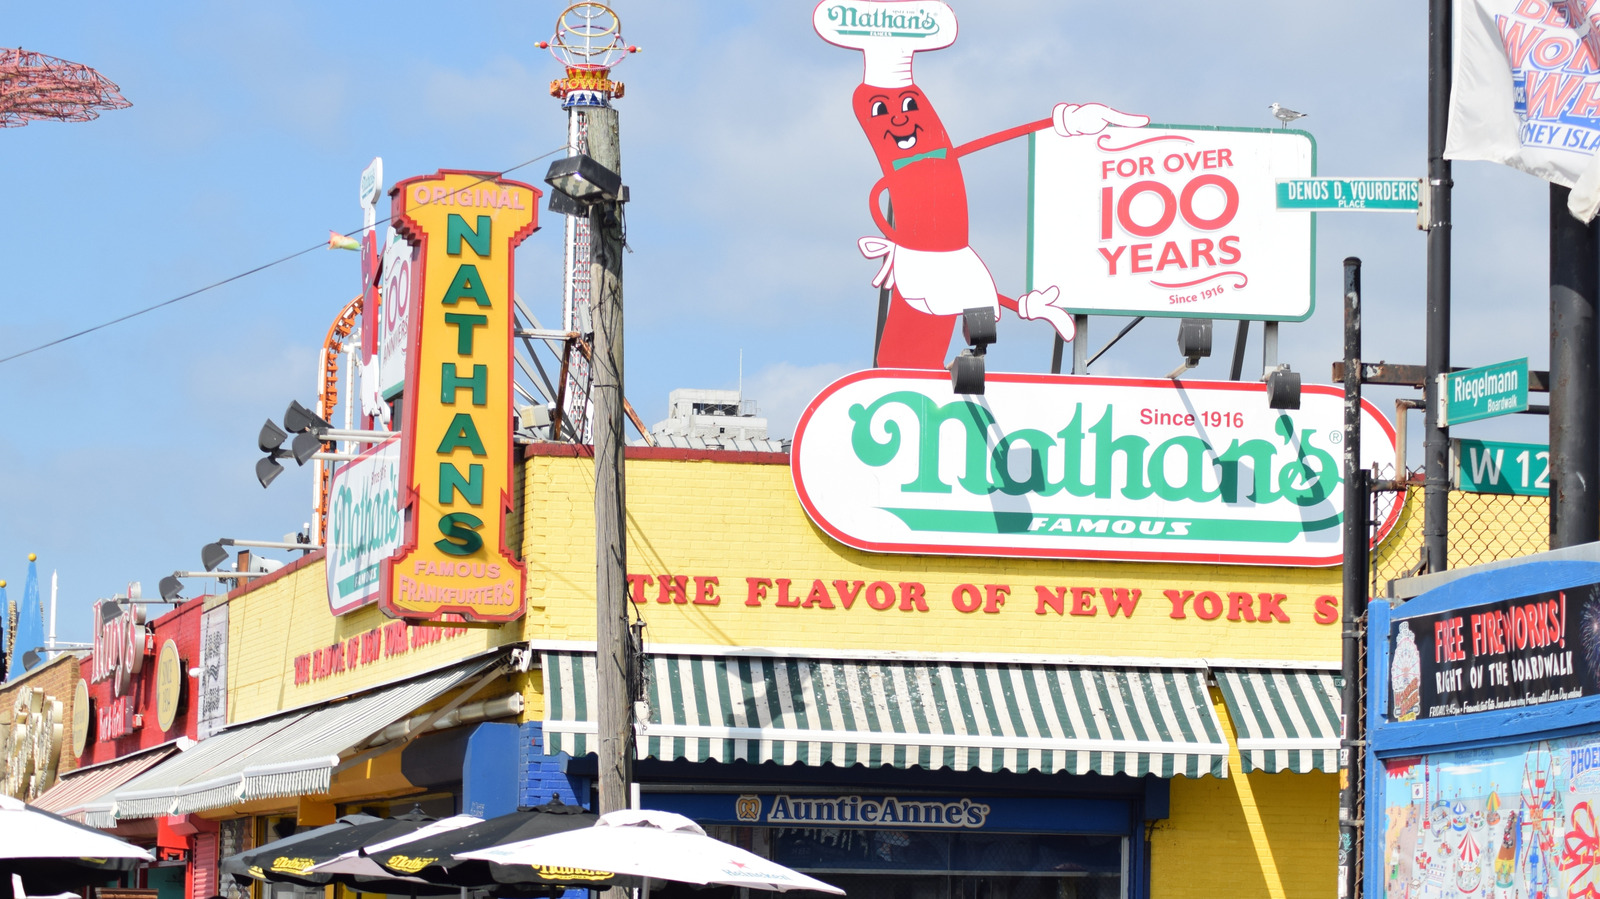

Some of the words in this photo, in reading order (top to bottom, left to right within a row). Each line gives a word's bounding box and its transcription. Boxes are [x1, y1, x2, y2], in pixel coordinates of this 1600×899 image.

[827, 5, 937, 30] Nathan's
[1101, 156, 1155, 180] FOR
[1163, 148, 1234, 173] OVER
[414, 185, 525, 210] ORIGINAL
[1288, 180, 1329, 201] DENOS
[1334, 181, 1346, 201] D.
[1351, 180, 1418, 201] VOURDERIS
[1338, 200, 1366, 208] PLACE
[1101, 174, 1240, 240] 100
[1097, 235, 1242, 276] YEARS
[1169, 293, 1198, 305] Since
[1199, 284, 1225, 300] 1916
[434, 213, 492, 556] NATHANS
[1454, 369, 1518, 407] Riegelmann
[1140, 407, 1196, 428] Since
[1201, 411, 1244, 429] 1916
[1487, 394, 1518, 413] Boardwalk
[848, 390, 1341, 507] Nathan's
[1469, 447, 1505, 485] W
[1026, 516, 1193, 537] FAMOUS
[413, 560, 501, 579] FAMOUS
[398, 573, 515, 606] FRANKFURTERS
[626, 574, 721, 606] THE
[744, 577, 930, 612] FLAVOR
[952, 583, 1011, 614] OF
[1034, 585, 1141, 618] NEW
[1162, 589, 1290, 623] YORK
[1434, 617, 1466, 663] FREE
[1470, 591, 1566, 657] FIREWORKS!
[1435, 668, 1463, 694] RIGHT
[1488, 661, 1509, 687] THE
[1512, 650, 1573, 683] BOARDWALK
